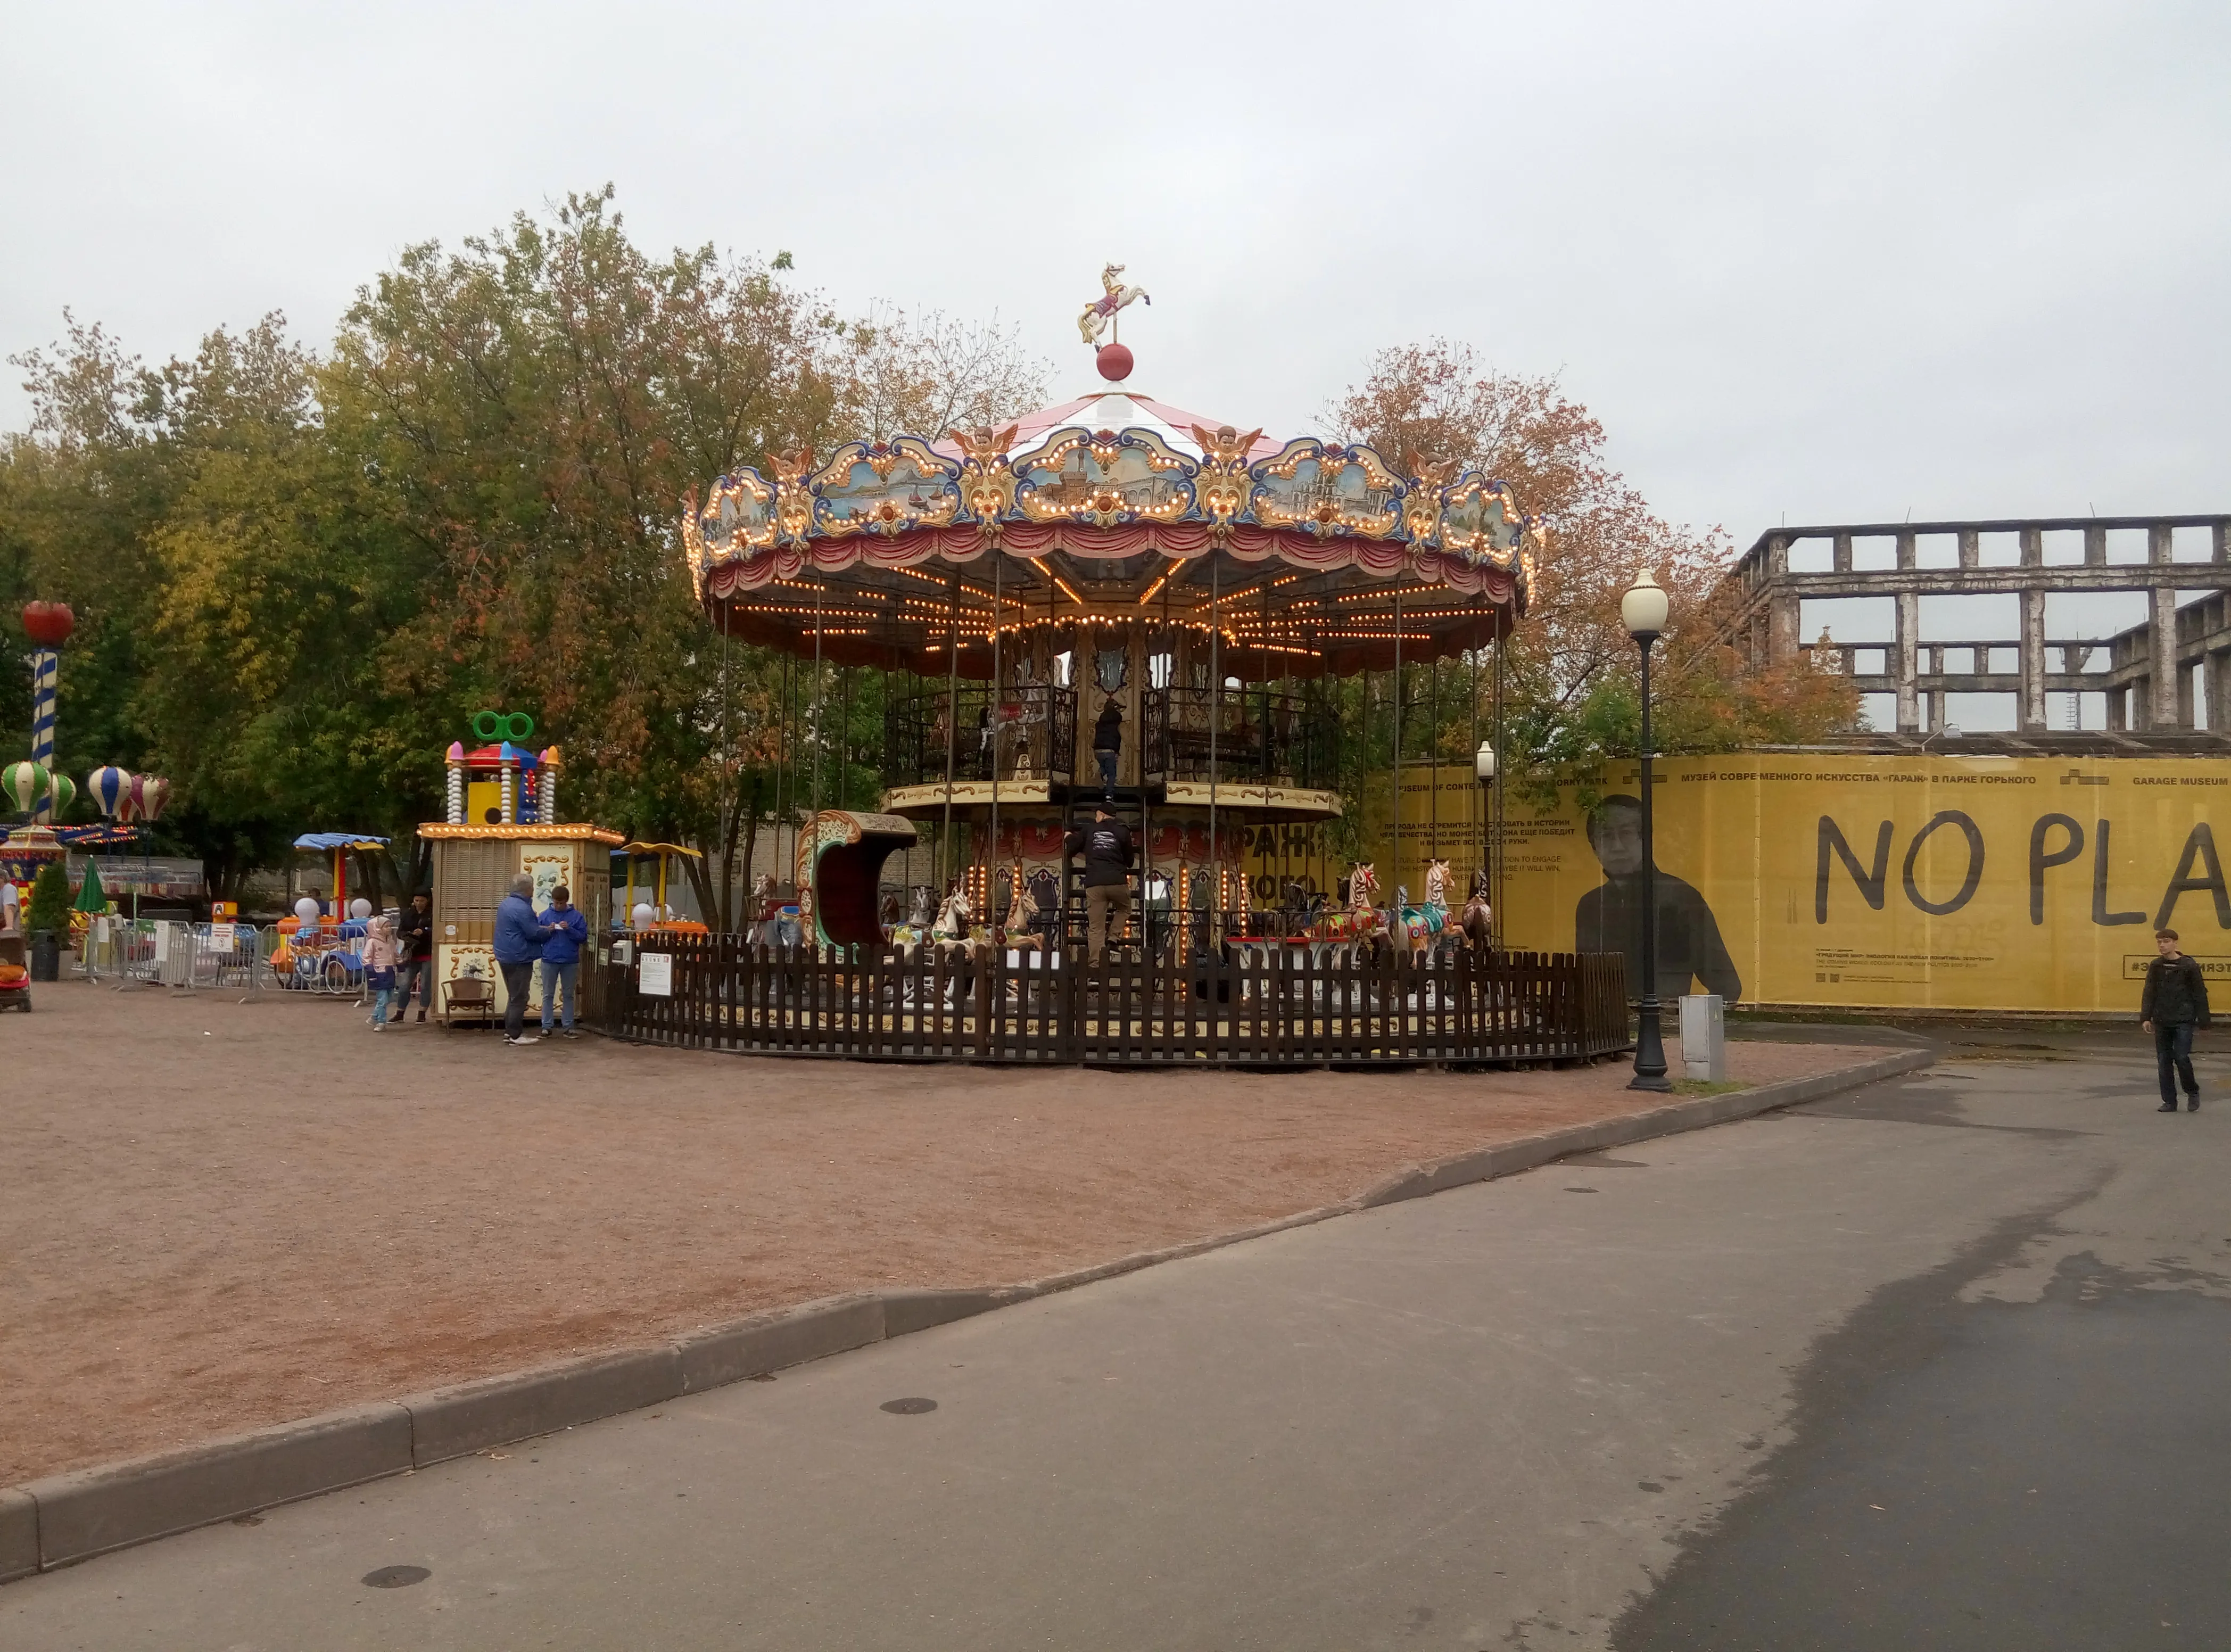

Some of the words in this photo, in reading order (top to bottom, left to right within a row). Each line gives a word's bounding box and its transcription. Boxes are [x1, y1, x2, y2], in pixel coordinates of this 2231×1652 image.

[1681, 771, 1716, 782] МУЗЕЙ
[1720, 772, 1812, 781] СОВРЕМЕННОГО
[1815, 810, 1985, 924] NO
